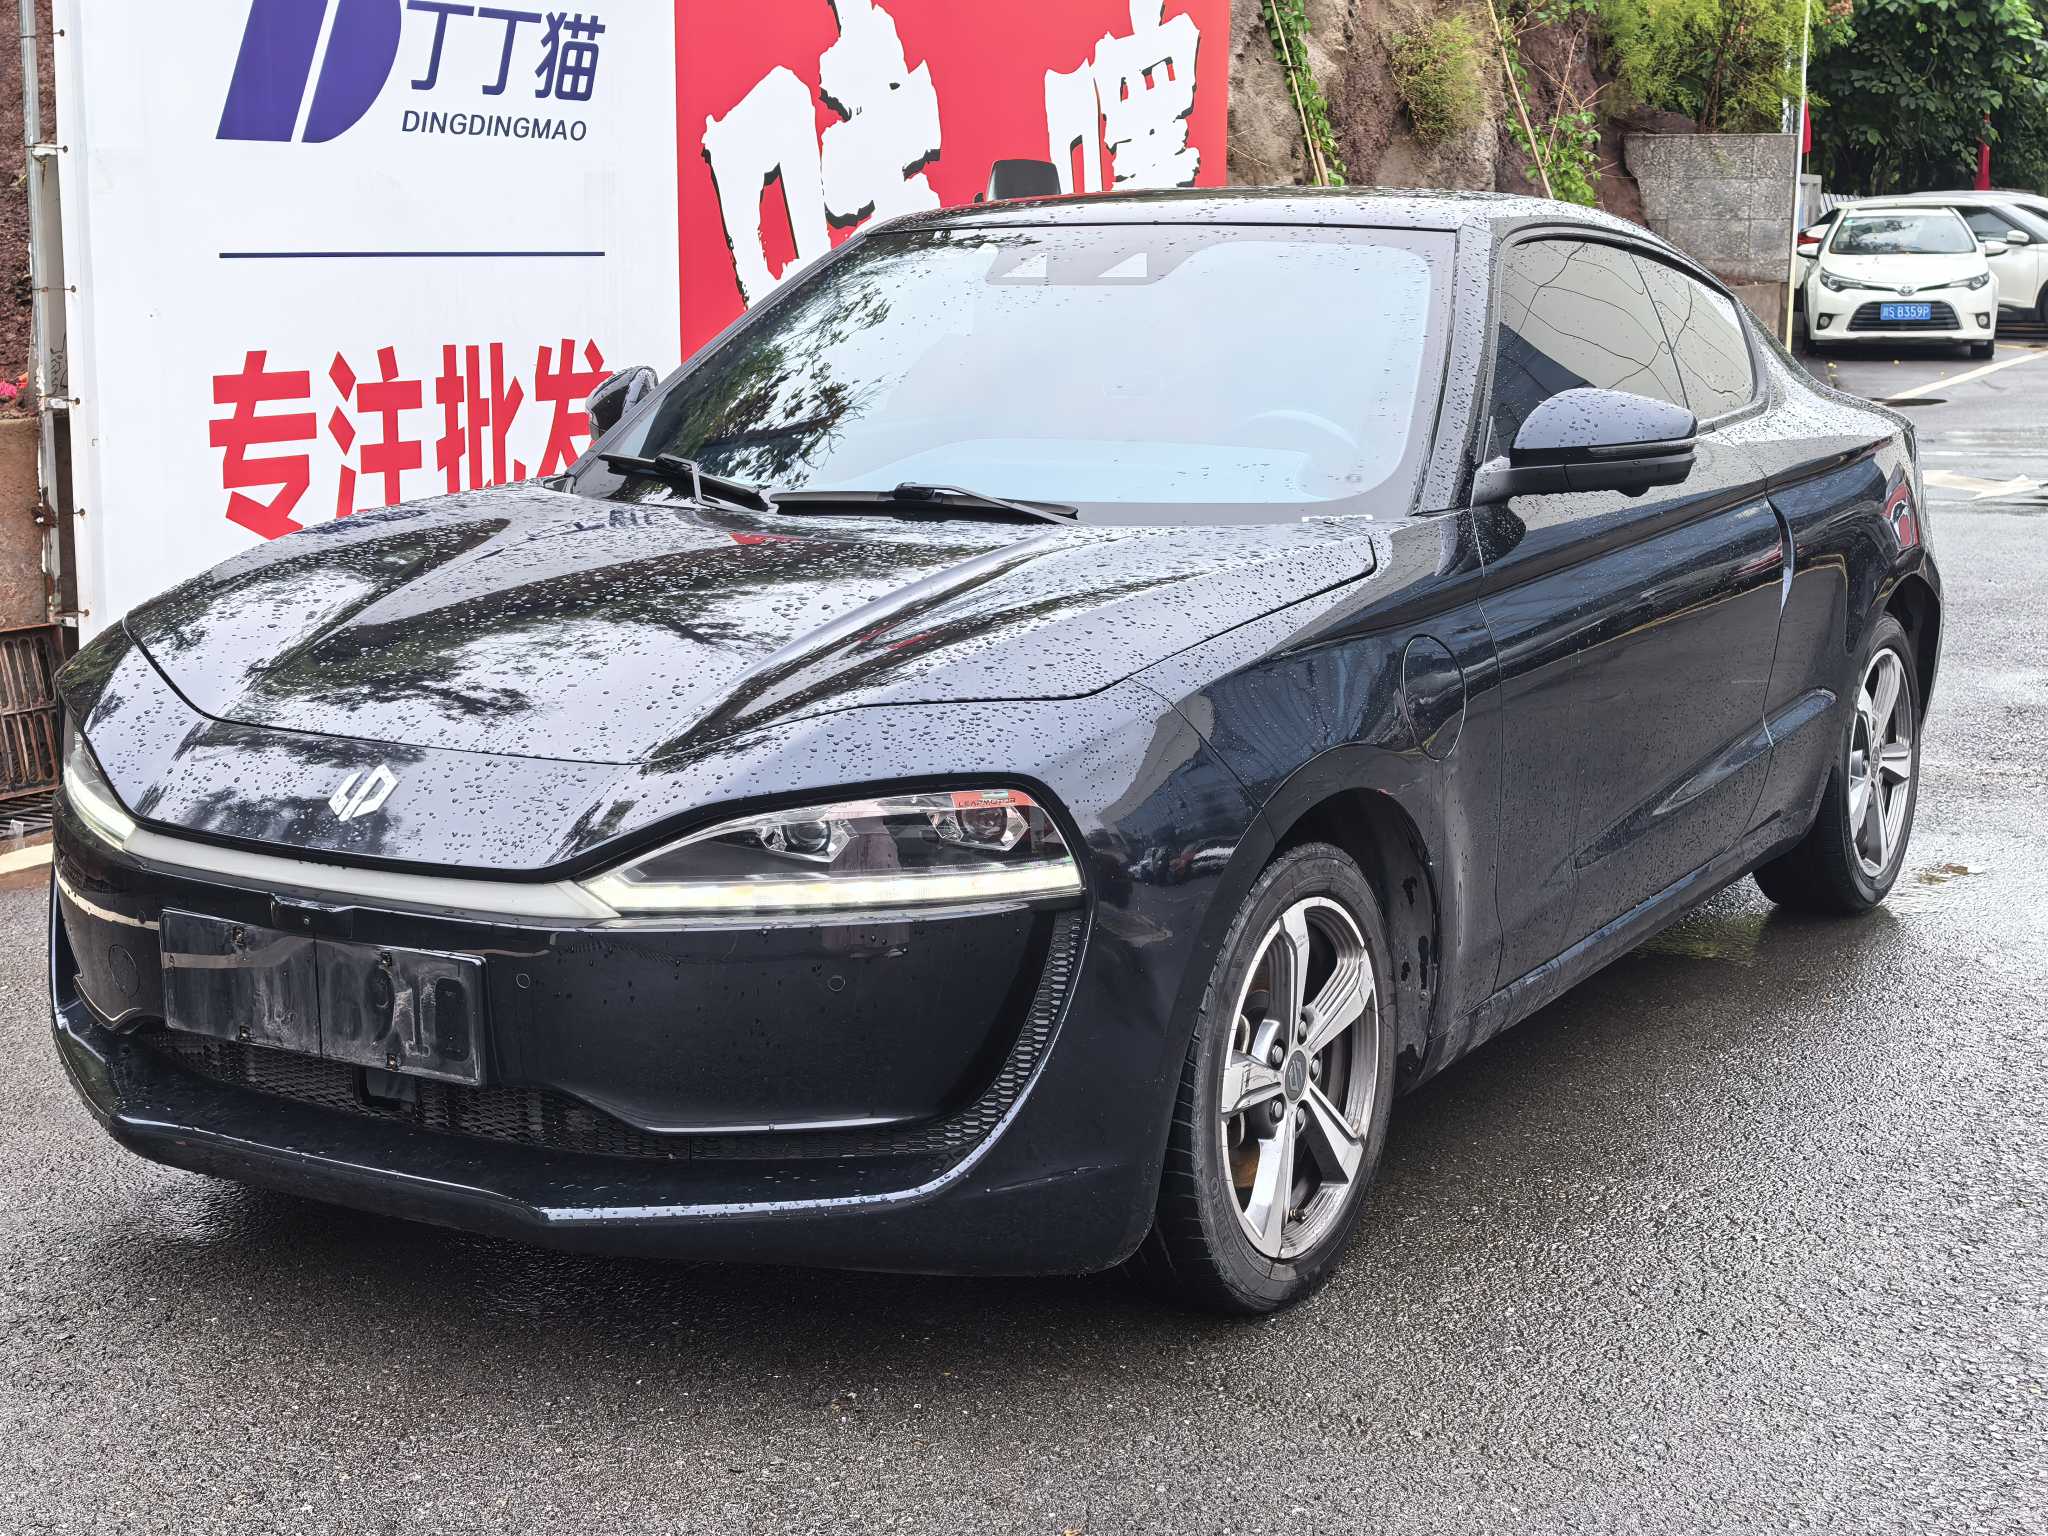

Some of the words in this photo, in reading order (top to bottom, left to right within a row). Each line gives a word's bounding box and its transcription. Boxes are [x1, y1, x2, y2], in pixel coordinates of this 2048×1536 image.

[406, 0, 605, 101] 丁丁猫
[402, 110, 587, 142] DINGDINGMAO
[209, 338, 613, 540] 专注批发
